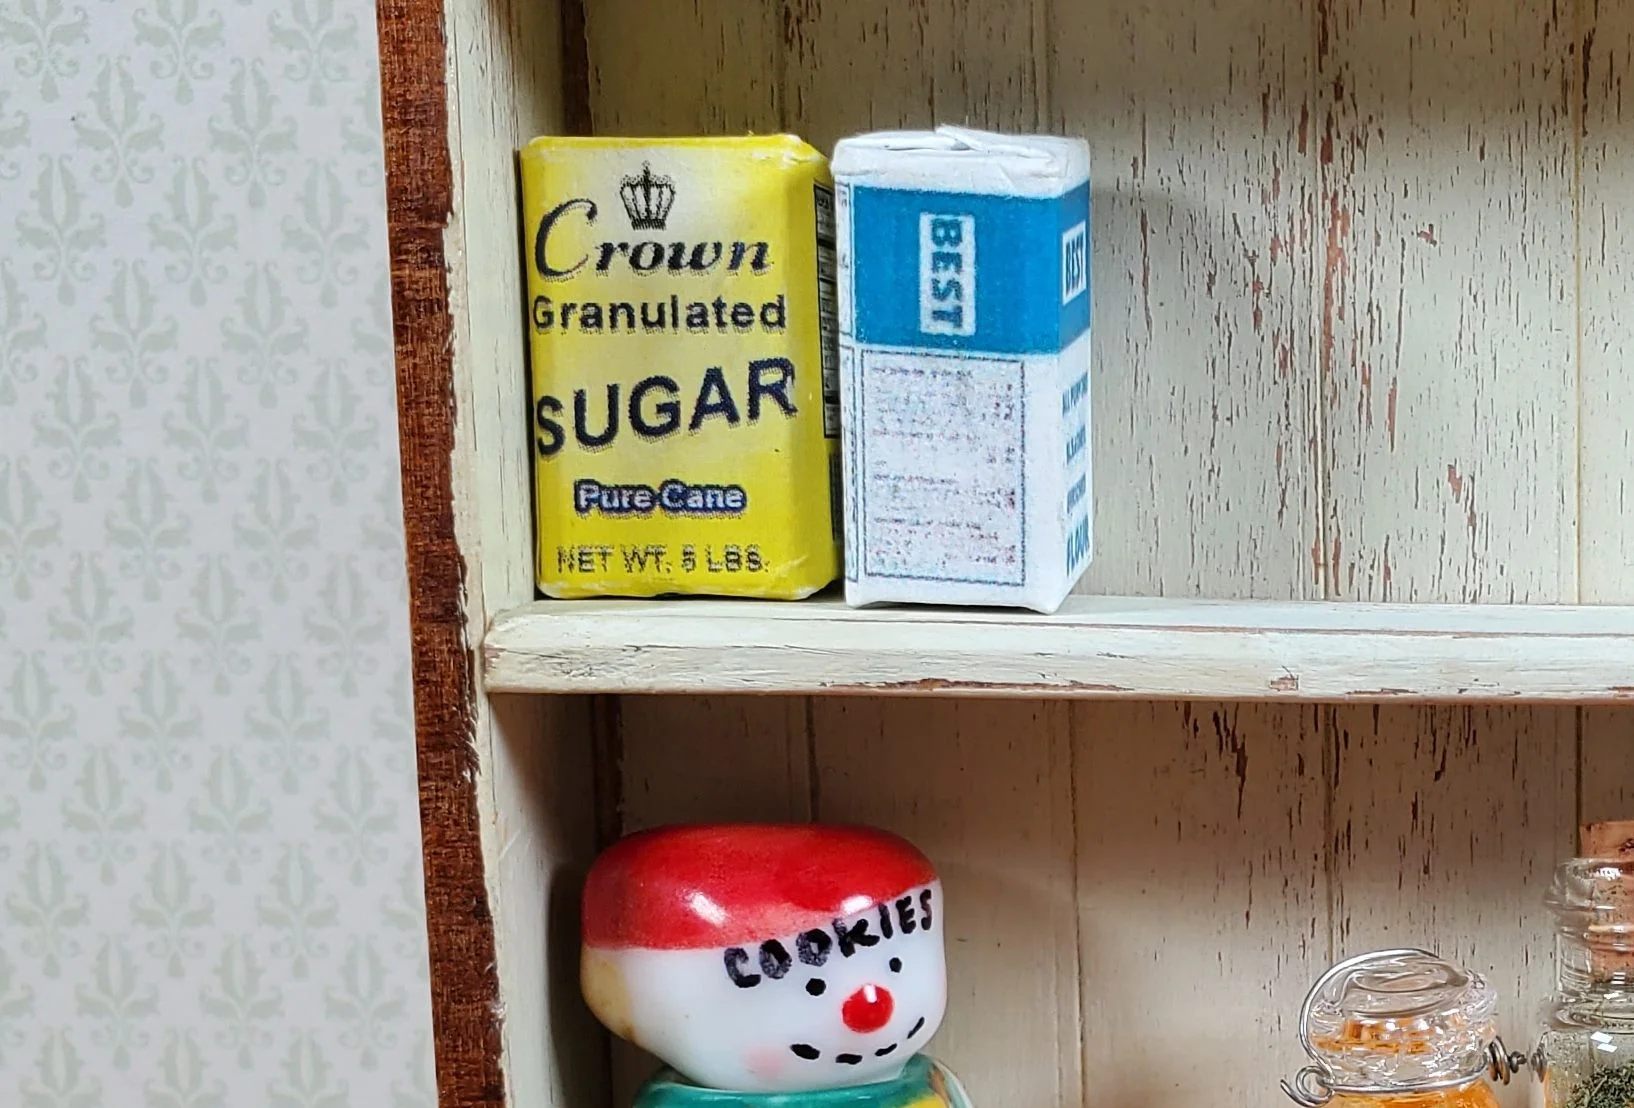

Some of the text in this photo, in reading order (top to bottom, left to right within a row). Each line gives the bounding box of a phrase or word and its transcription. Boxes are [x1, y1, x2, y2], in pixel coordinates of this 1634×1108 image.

[534, 198, 774, 280] Crown
[931, 218, 963, 328] BEST
[1065, 231, 1085, 297] BEST
[533, 294, 787, 333] Granulated
[536, 358, 799, 461] SUGAR
[575, 480, 747, 515] Pure Cane
[556, 545, 614, 573] NET
[724, 889, 932, 988] COOKIES
